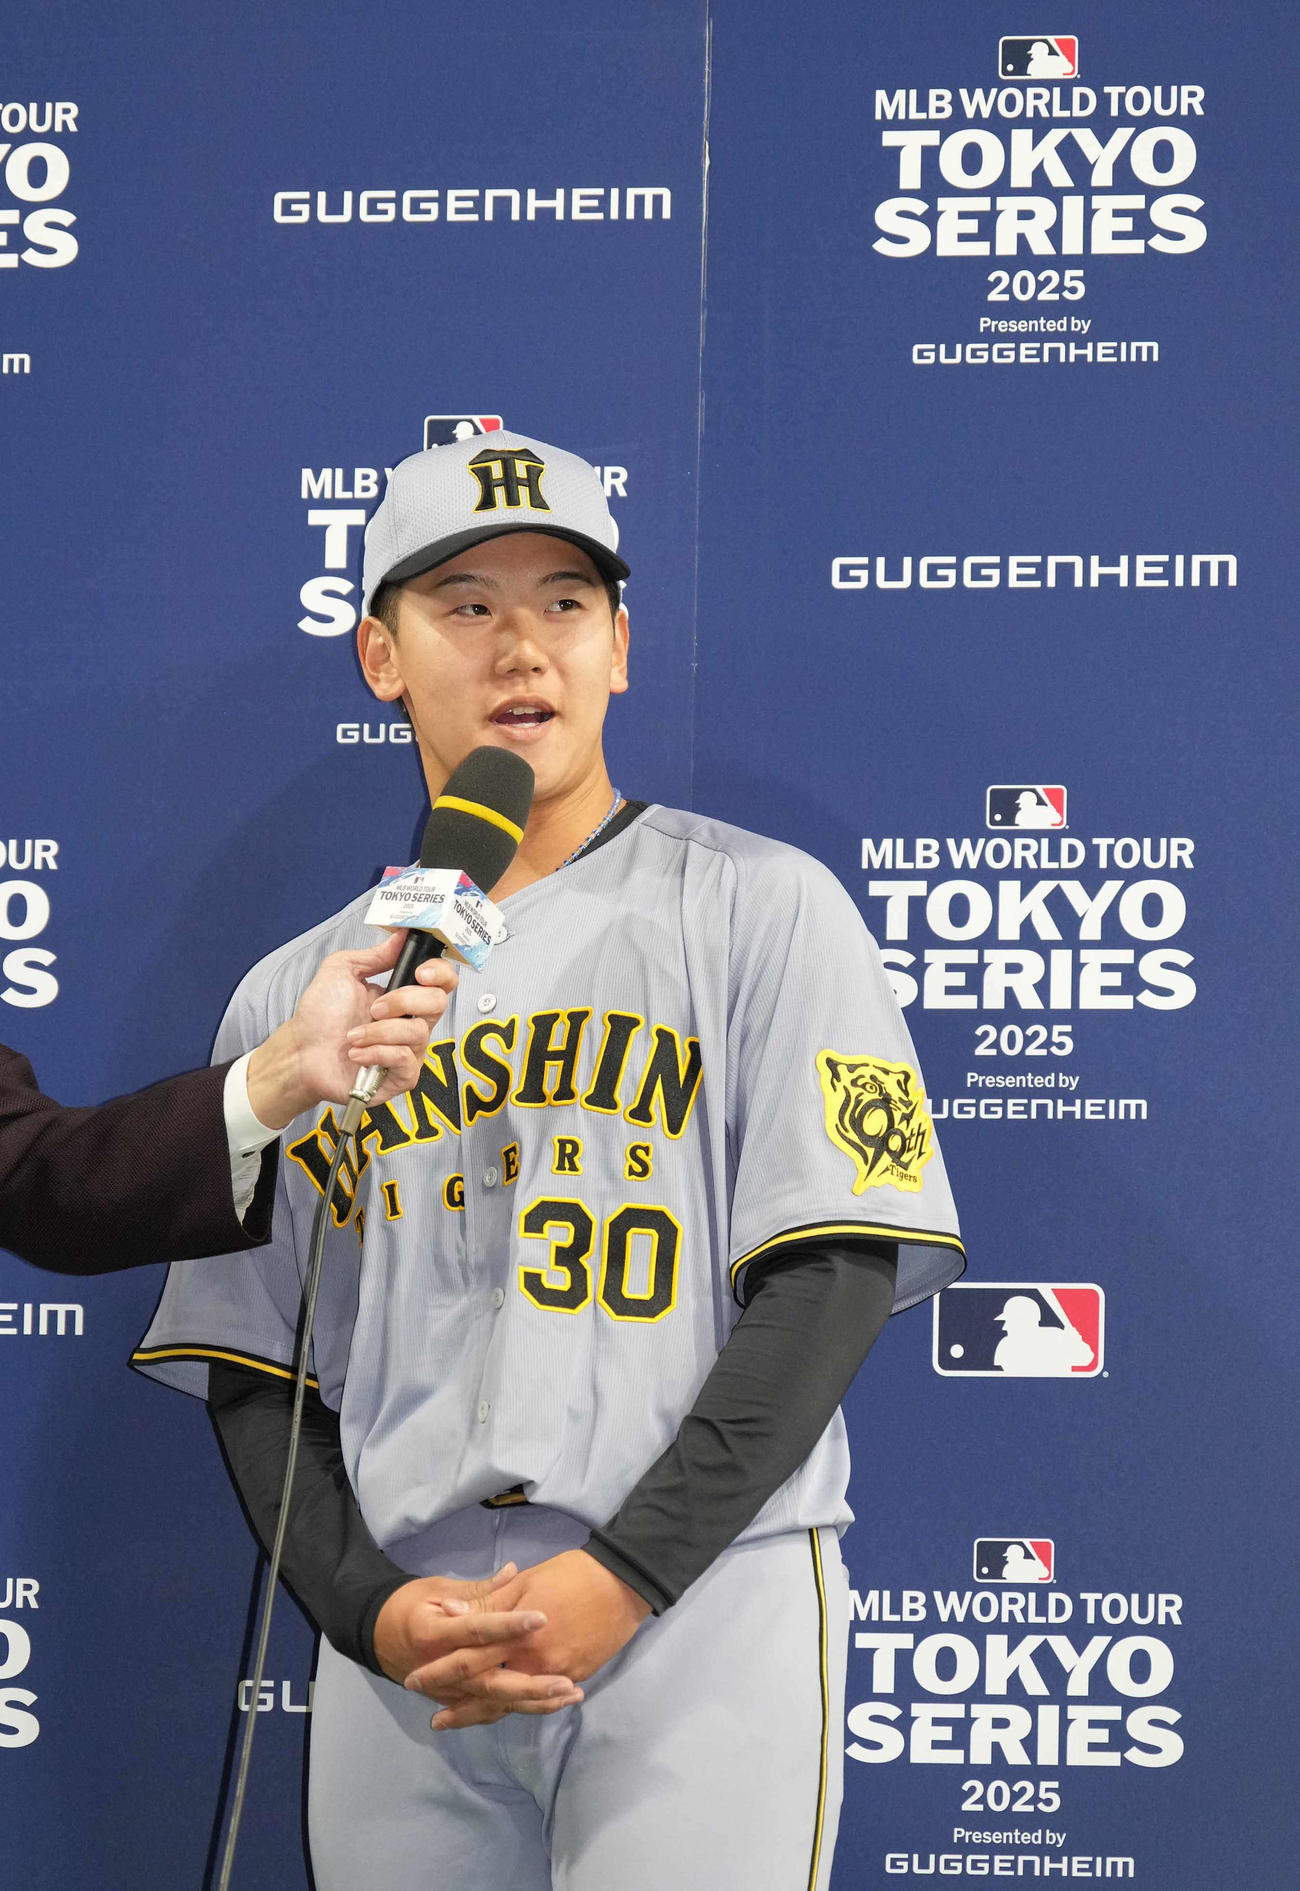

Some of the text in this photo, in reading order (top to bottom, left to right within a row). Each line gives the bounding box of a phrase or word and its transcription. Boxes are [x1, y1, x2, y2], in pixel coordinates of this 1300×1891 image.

[0, 102, 78, 133] OUR
[875, 85, 1205, 120] MLB WORLD TOUR
[882, 126, 1197, 189] TOKYO
[273, 187, 672, 223] GUGGENHEIM
[872, 194, 1208, 257] SERIES
[987, 270, 1086, 301] 2025
[979, 317, 1092, 335] Presented by
[912, 342, 1159, 364] GUGGENHEIM
[301, 468, 378, 499] MLB
[831, 554, 1238, 589] GUGGENHEIM
[861, 838, 1195, 870] MLB WORLD TOUR
[380, 890, 445, 904] TOKYO SERIES
[868, 880, 1186, 941] TOKYO
[453, 899, 473, 925] TOKYO
[470, 919, 492, 946] SERIES
[880, 948, 1196, 1011] SERIES
[974, 1025, 1074, 1056] 2025
[967, 1073, 1080, 1091] Presented by
[928, 1099, 1148, 1120] UGGENHEIM
[888, 1163, 918, 1184] Tigers
[518, 1195, 683, 1324] 30
[849, 1589, 1183, 1625] MLB WORLD TOUR
[855, 1632, 1174, 1698] TOKYO
[845, 1702, 1185, 1768] SERIES
[961, 1780, 1061, 1813] 2025
[953, 1828, 1067, 1848] Presented by
[885, 1853, 1135, 1878] GUGGENHEIM
